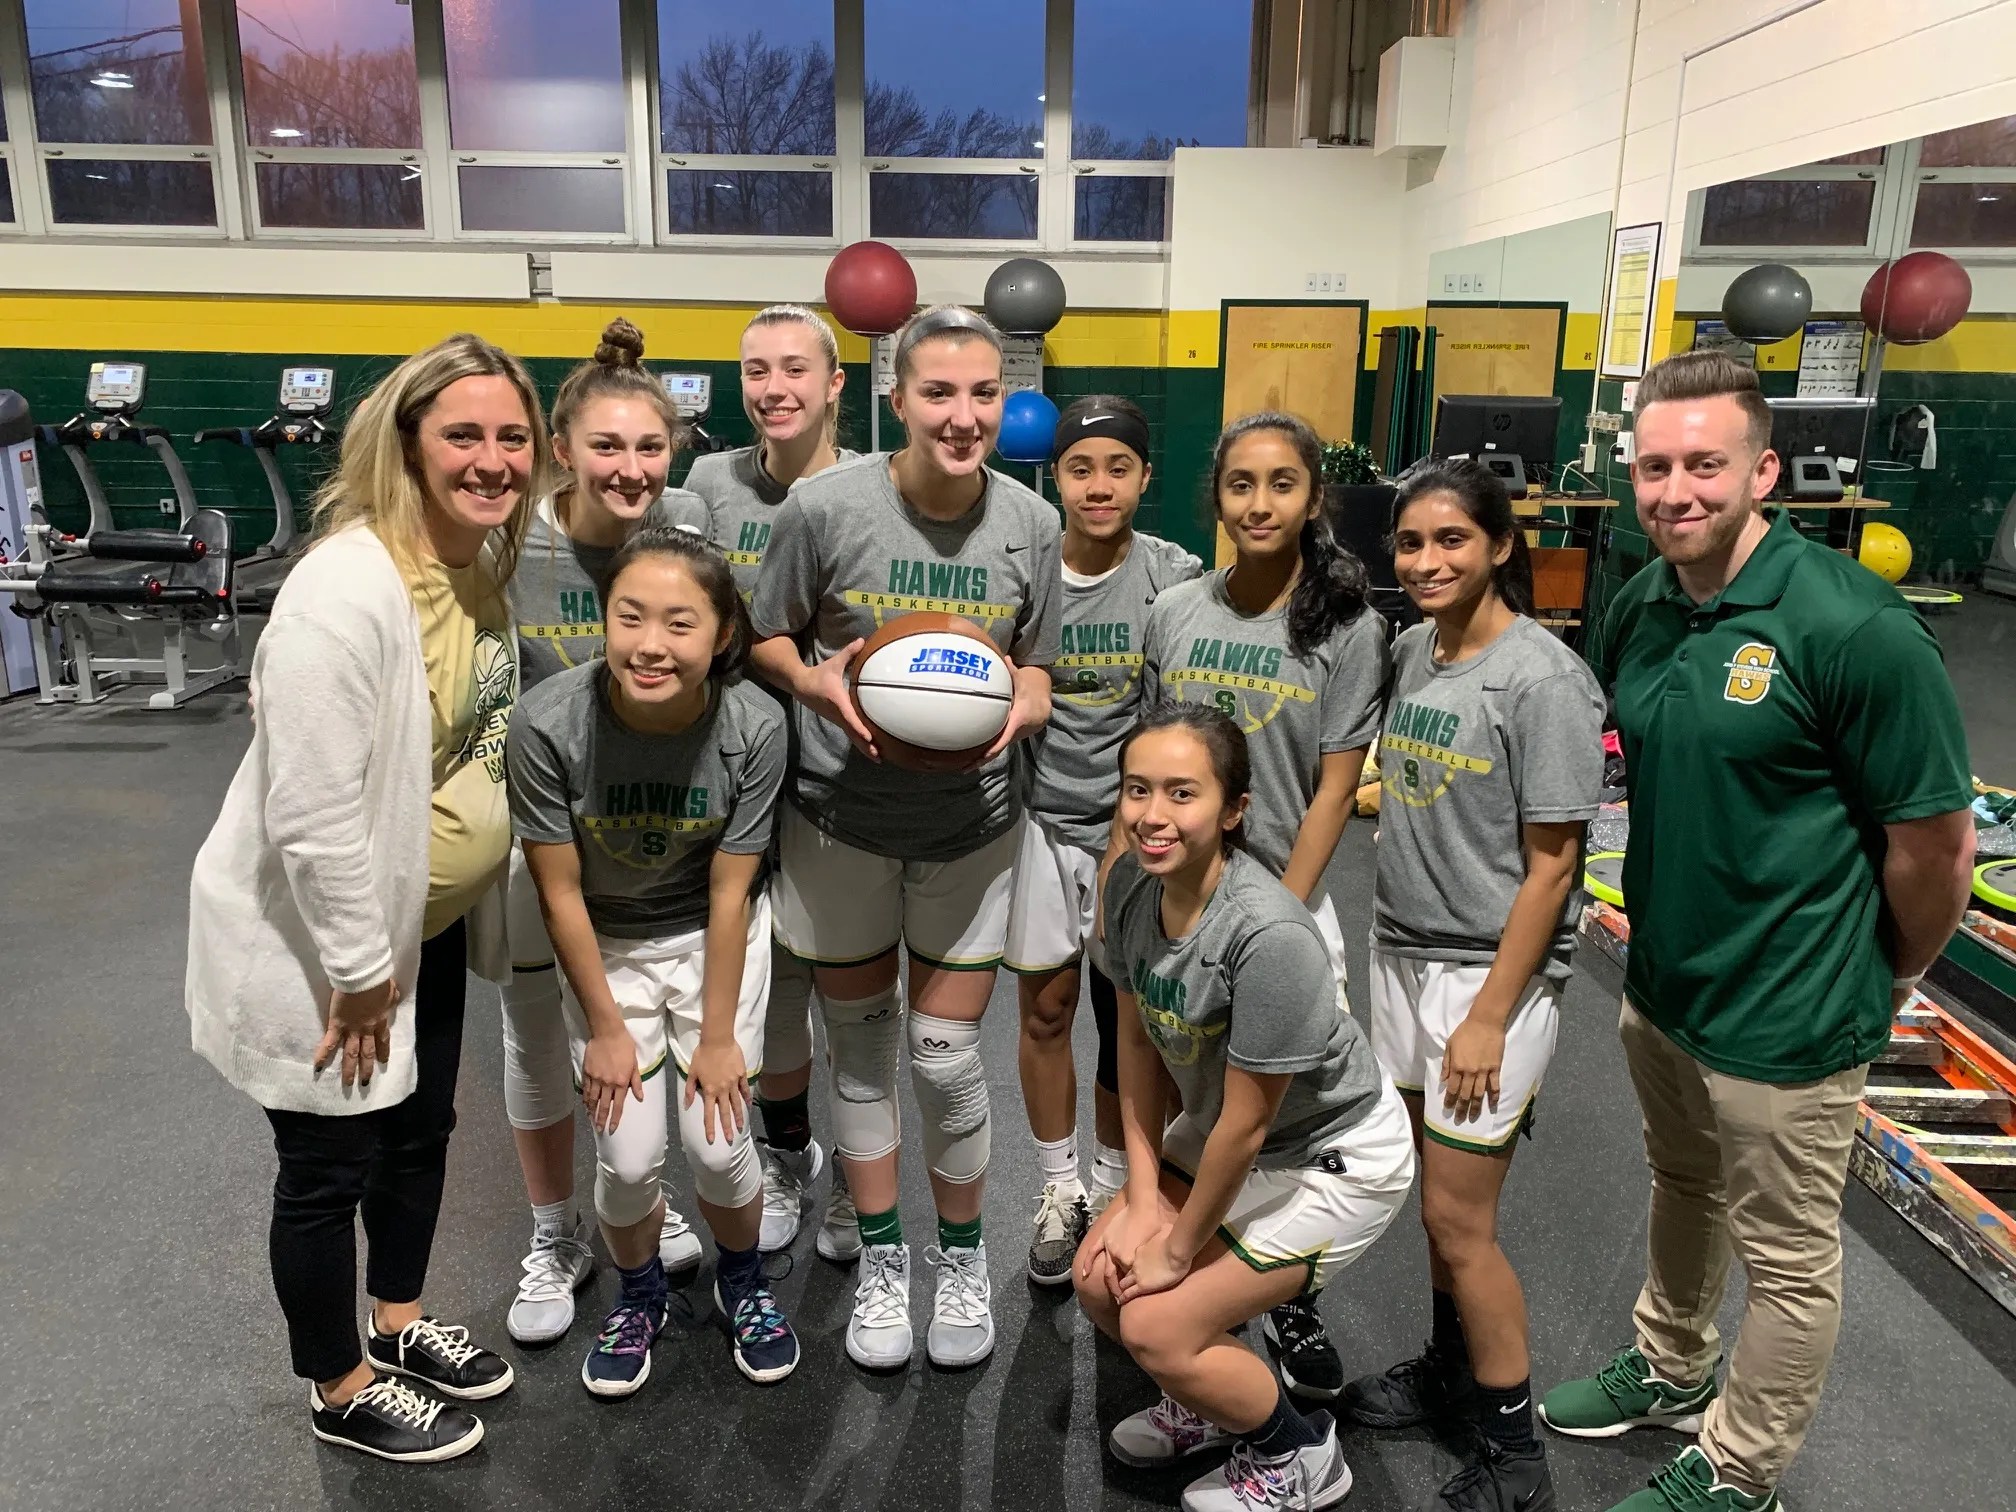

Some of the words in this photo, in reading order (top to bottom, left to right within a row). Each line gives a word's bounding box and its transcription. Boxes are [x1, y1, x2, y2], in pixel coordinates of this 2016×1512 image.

[1188, 350, 1197, 359] 26
[888, 559, 988, 602] HAWKS
[861, 593, 1005, 616] BASKETBALL
[1061, 622, 1130, 654] AWKS
[911, 664, 956, 672] SPORTS
[1187, 638, 1283, 679] HAWKS
[1171, 671, 1299, 698] BASKETBALL
[1730, 668, 1772, 682] HAWKS
[1388, 700, 1460, 748] HAWKS
[1382, 737, 1472, 769] SKETBALL
[606, 783, 709, 818] HAWKS
[578, 816, 716, 831] BASKETBAL
[641, 831, 668, 857] S
[1140, 999, 1209, 1037] KETBALL
[1328, 1159, 1337, 1169] S
